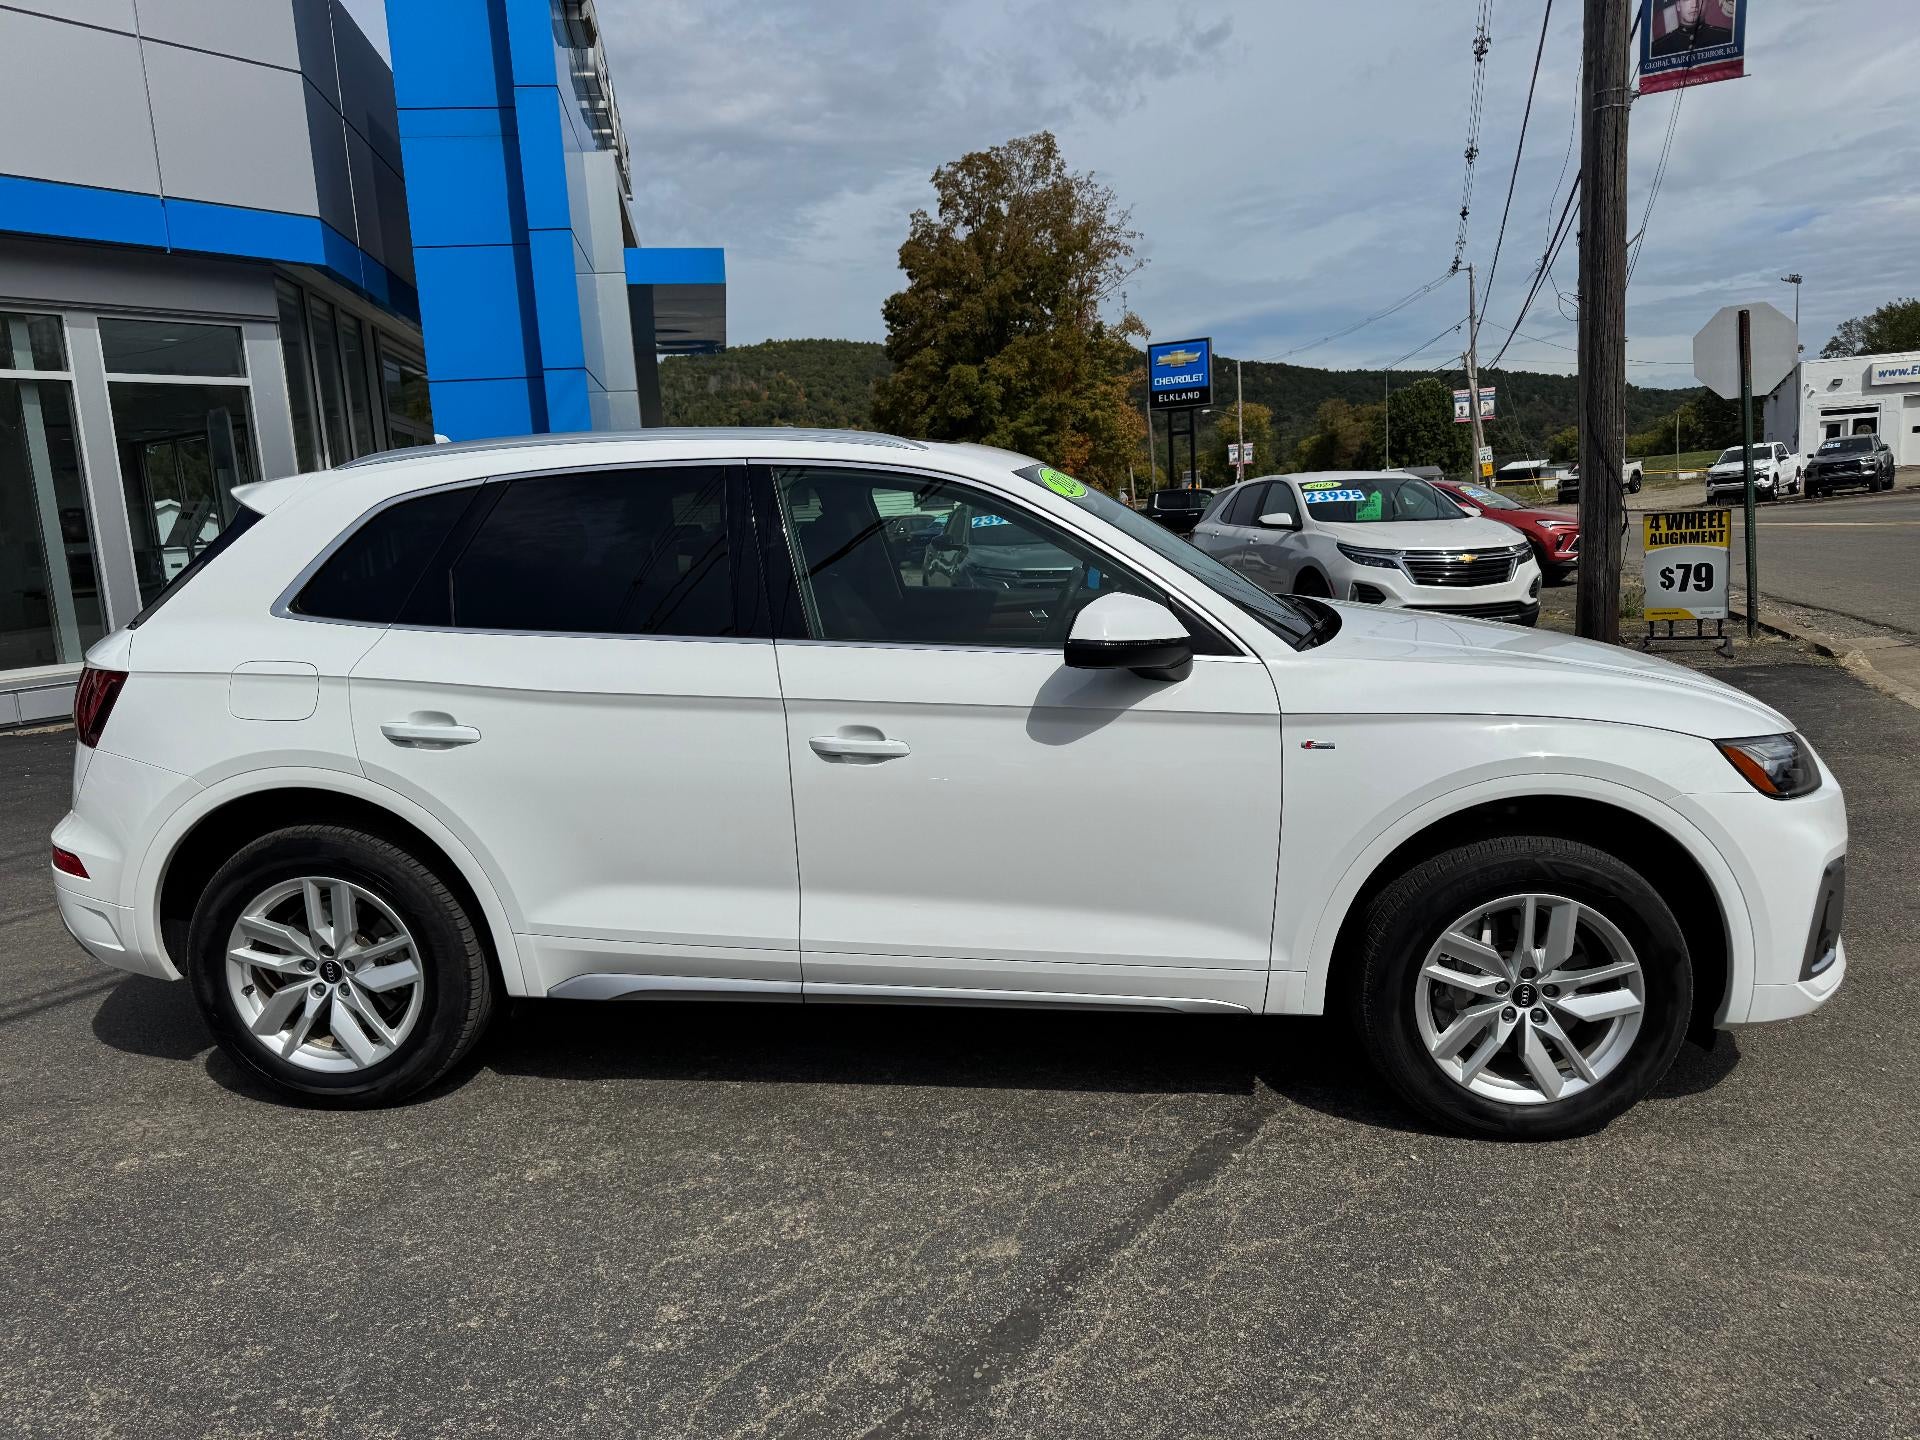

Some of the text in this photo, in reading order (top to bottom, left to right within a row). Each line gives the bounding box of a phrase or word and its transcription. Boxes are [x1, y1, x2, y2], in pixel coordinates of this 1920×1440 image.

[1644, 58, 1670, 70] GLOBAL
[1671, 55, 1685, 65] WAR
[1726, 46, 1738, 55] KIA
[1154, 373, 1204, 386] CHEVROLET
[1158, 391, 1200, 403] ELKLAND
[1305, 491, 1363, 502] 23995
[1649, 511, 1726, 531] 4 WHEEL
[1649, 530, 1726, 546] ALIGNMENT
[1659, 562, 1714, 593] $79
